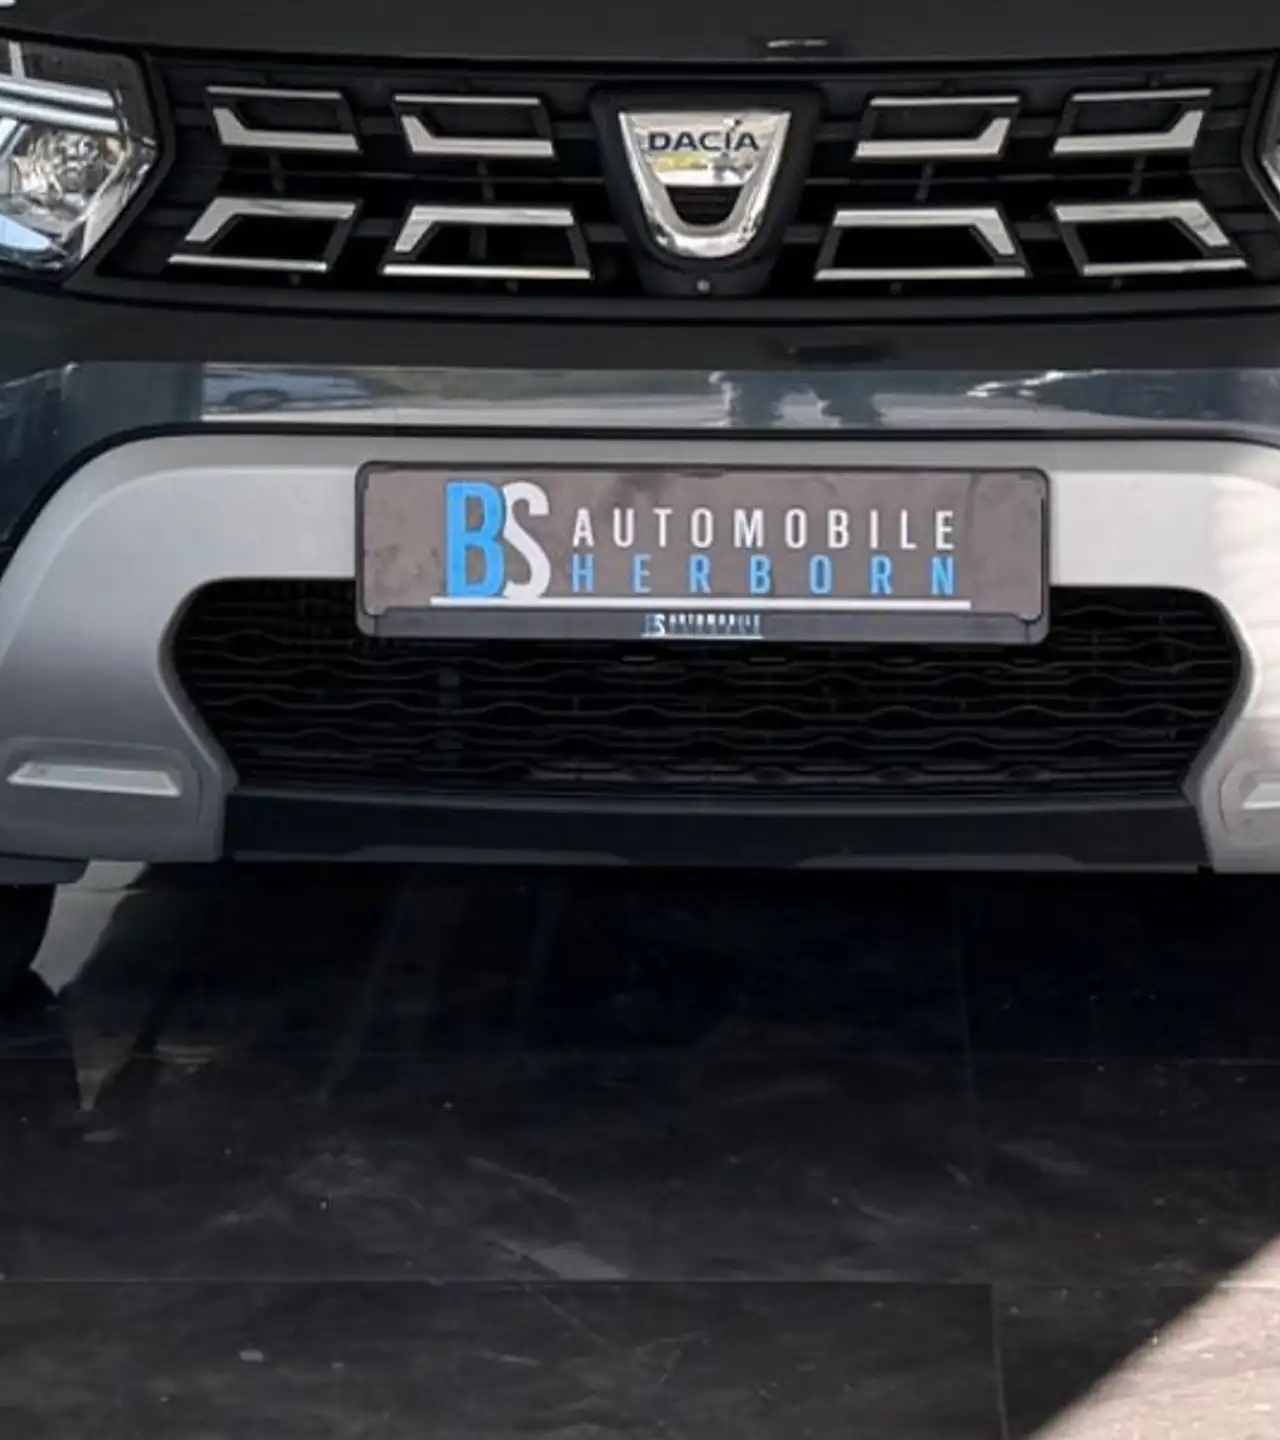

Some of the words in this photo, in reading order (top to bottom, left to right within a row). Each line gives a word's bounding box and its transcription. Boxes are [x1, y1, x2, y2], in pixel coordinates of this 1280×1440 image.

[648, 131, 759, 151] DACIA
[446, 481, 551, 598] BS
[572, 507, 955, 550] AUTOMOBILE
[572, 554, 954, 596] HERBORN
